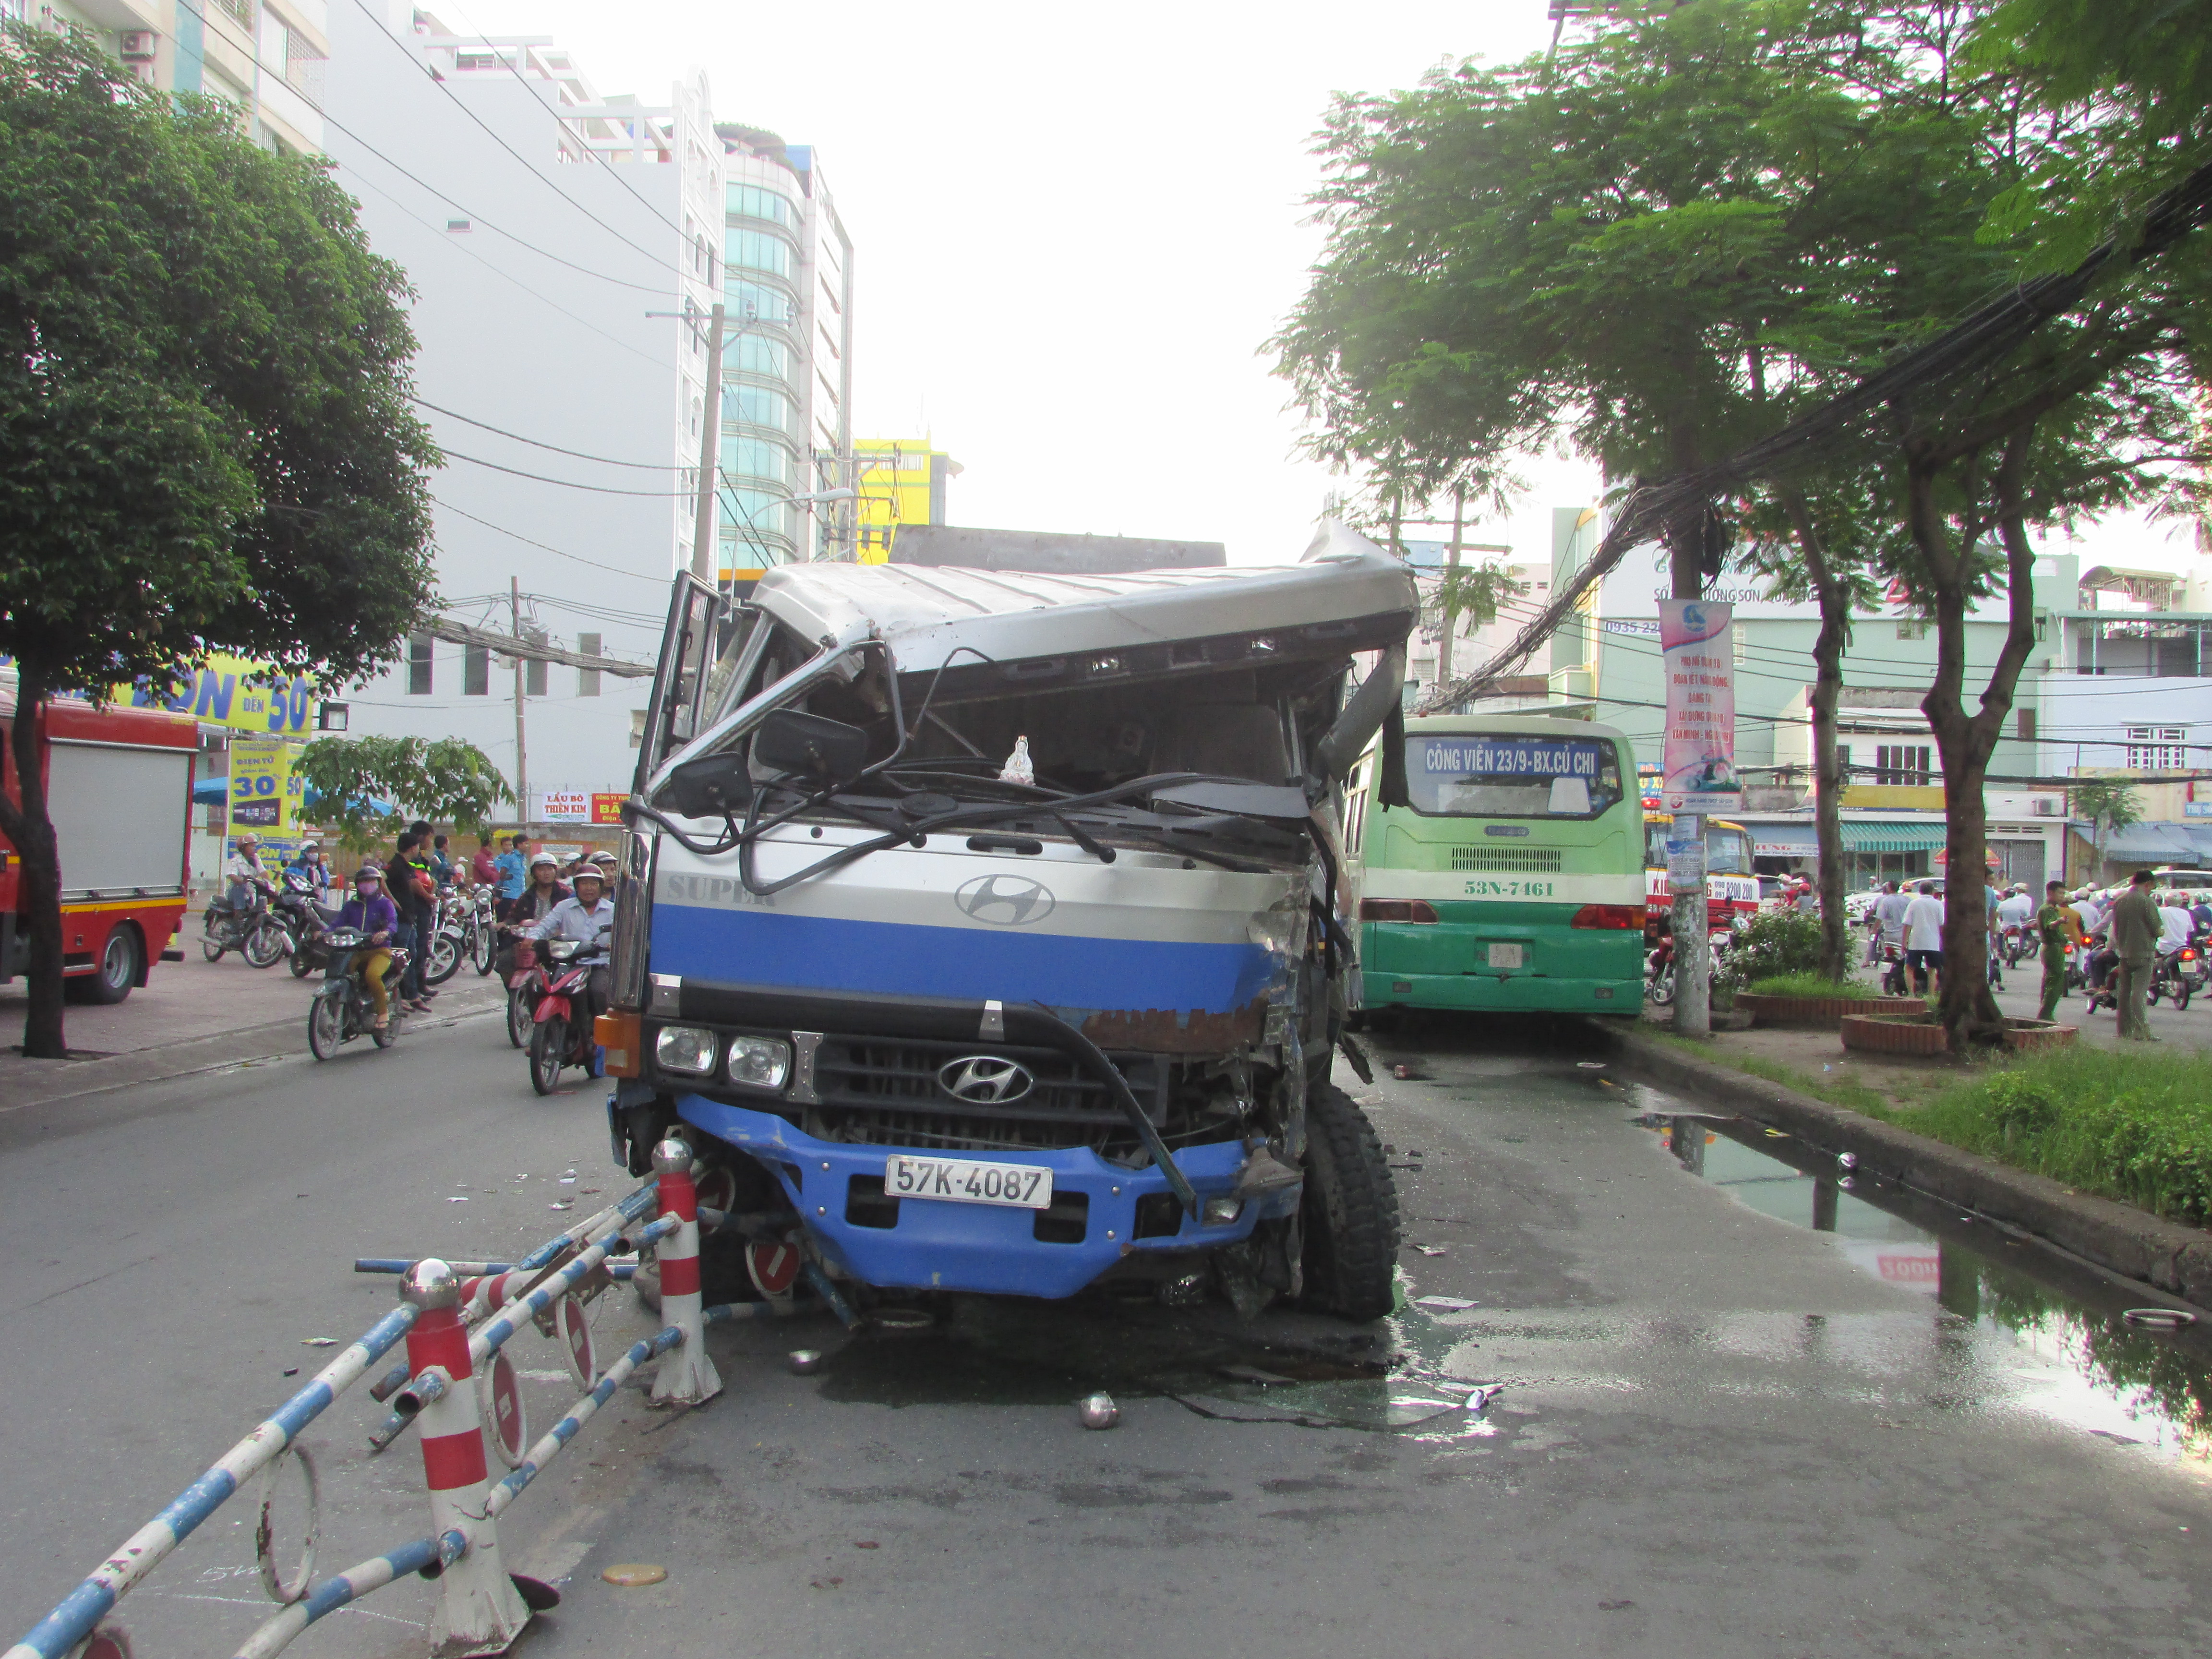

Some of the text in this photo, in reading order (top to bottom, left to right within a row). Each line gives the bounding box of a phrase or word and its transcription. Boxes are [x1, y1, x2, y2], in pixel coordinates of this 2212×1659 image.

[1605, 621, 1661, 633] 0935 22
[1426, 743, 1460, 770] CÔNG
[1464, 744, 1493, 771] VIÊN
[1574, 751, 1595, 775] CHI
[571, 805, 587, 813] KIM
[1464, 880, 1553, 896] 53N-7461
[897, 1160, 1042, 1201] 57K-4087
